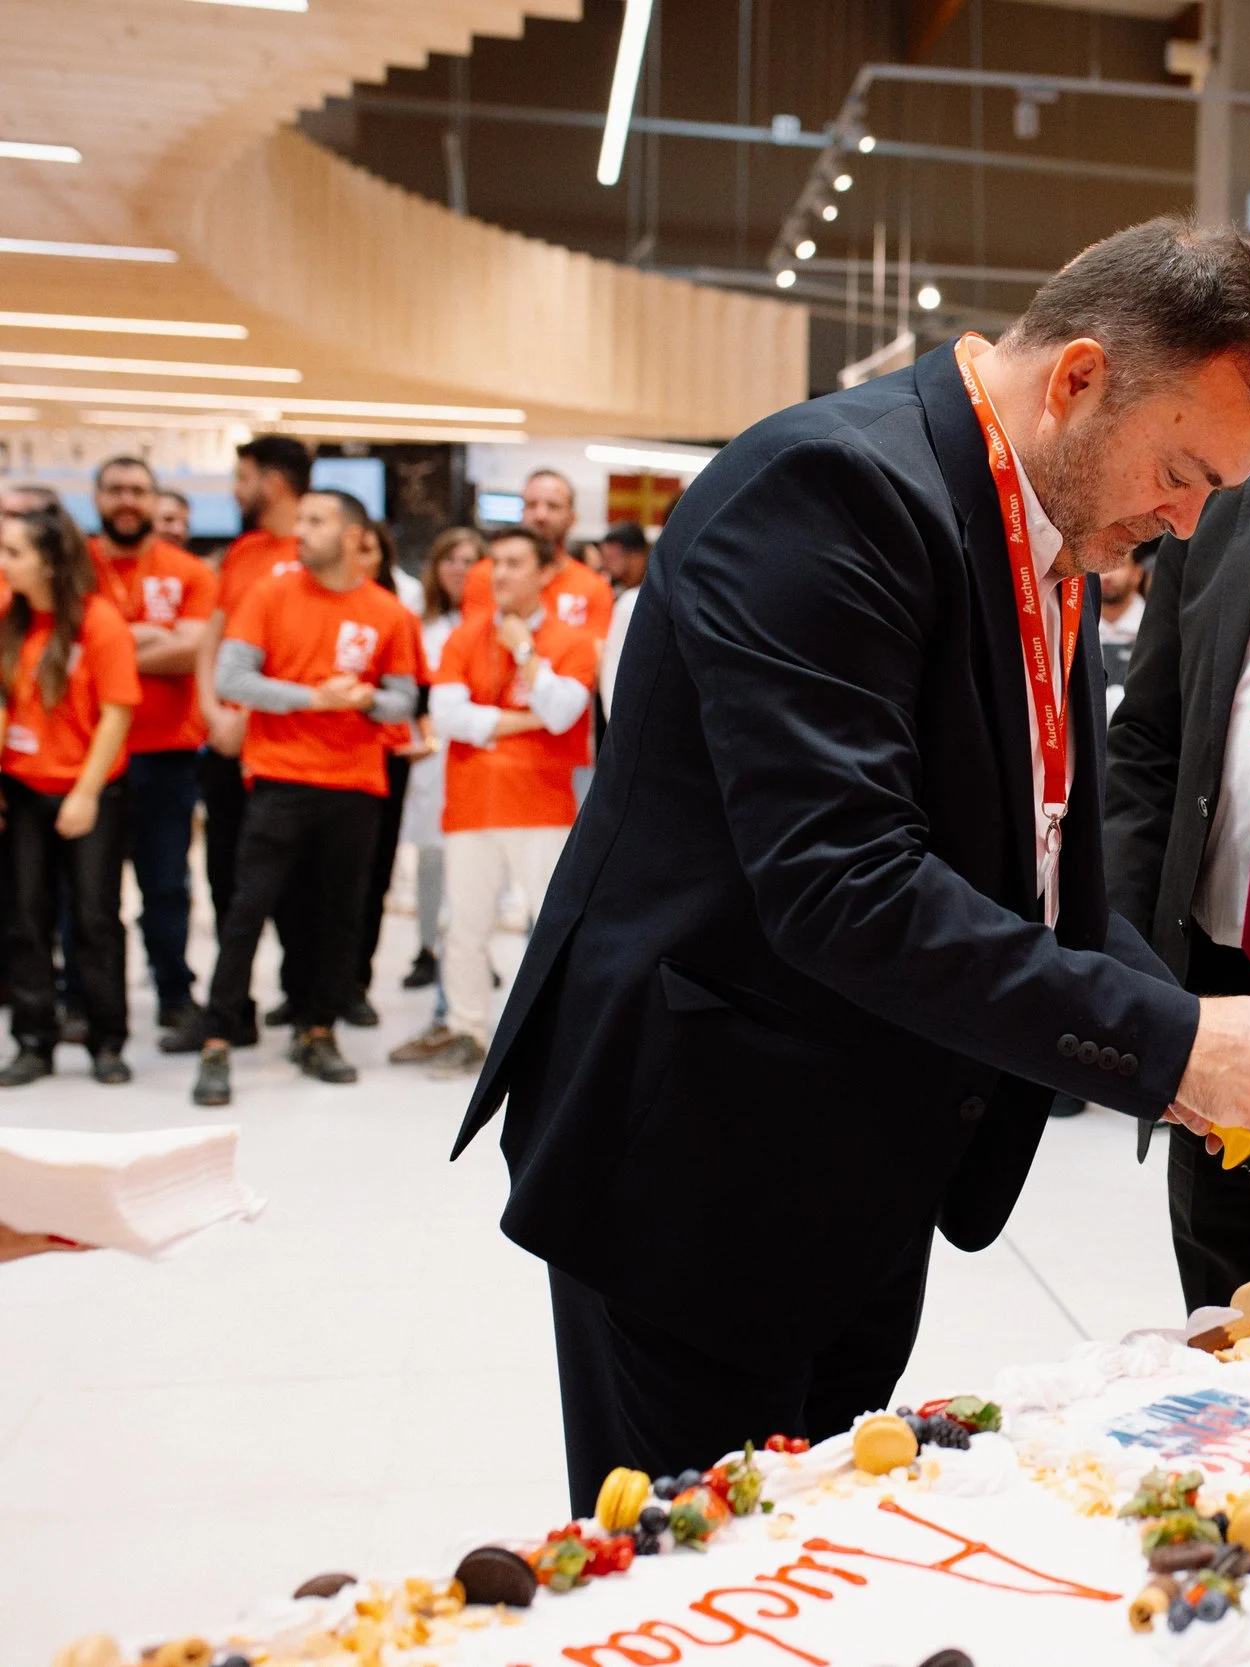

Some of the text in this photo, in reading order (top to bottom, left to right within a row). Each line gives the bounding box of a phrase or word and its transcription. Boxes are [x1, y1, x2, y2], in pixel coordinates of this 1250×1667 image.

[960, 362, 983, 405] Auchan
[986, 423, 1010, 470] Auchan
[1009, 493, 1024, 543] Auchan
[1020, 566, 1036, 615] Auchan
[1066, 576, 1079, 610] Auch
[1032, 637, 1048, 683] Auchan
[1044, 704, 1059, 749] Auchan
[507, 1501, 1123, 1667] Aucha
